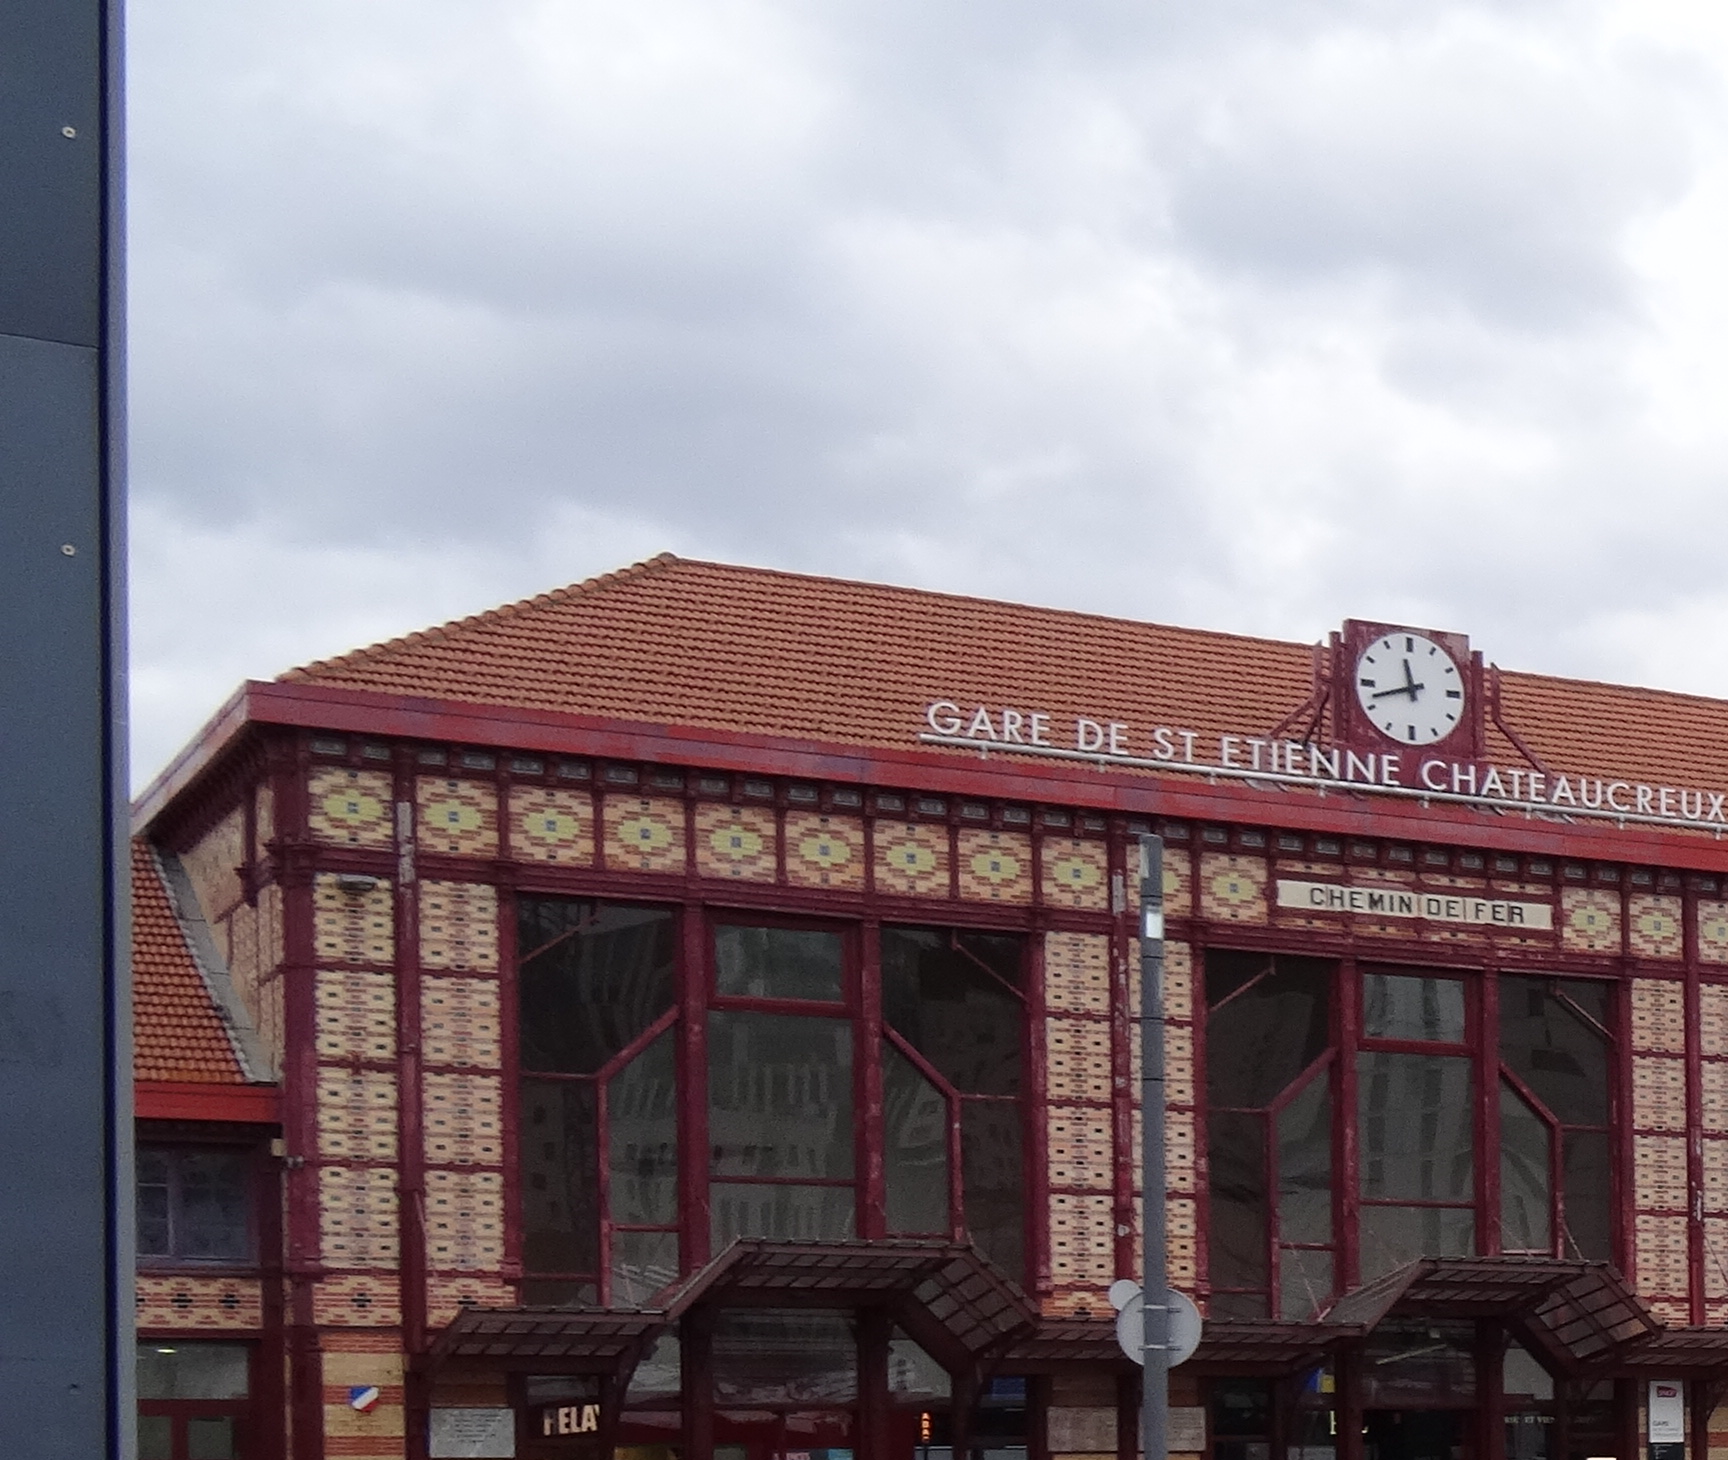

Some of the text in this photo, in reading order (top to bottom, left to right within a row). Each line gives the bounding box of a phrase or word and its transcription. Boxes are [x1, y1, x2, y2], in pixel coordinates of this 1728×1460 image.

[928, 701, 1727, 822] GARE DE ST ETIENNE CHATEAUCREUX
[1309, 886, 1525, 924] CHEMIN DE FER
